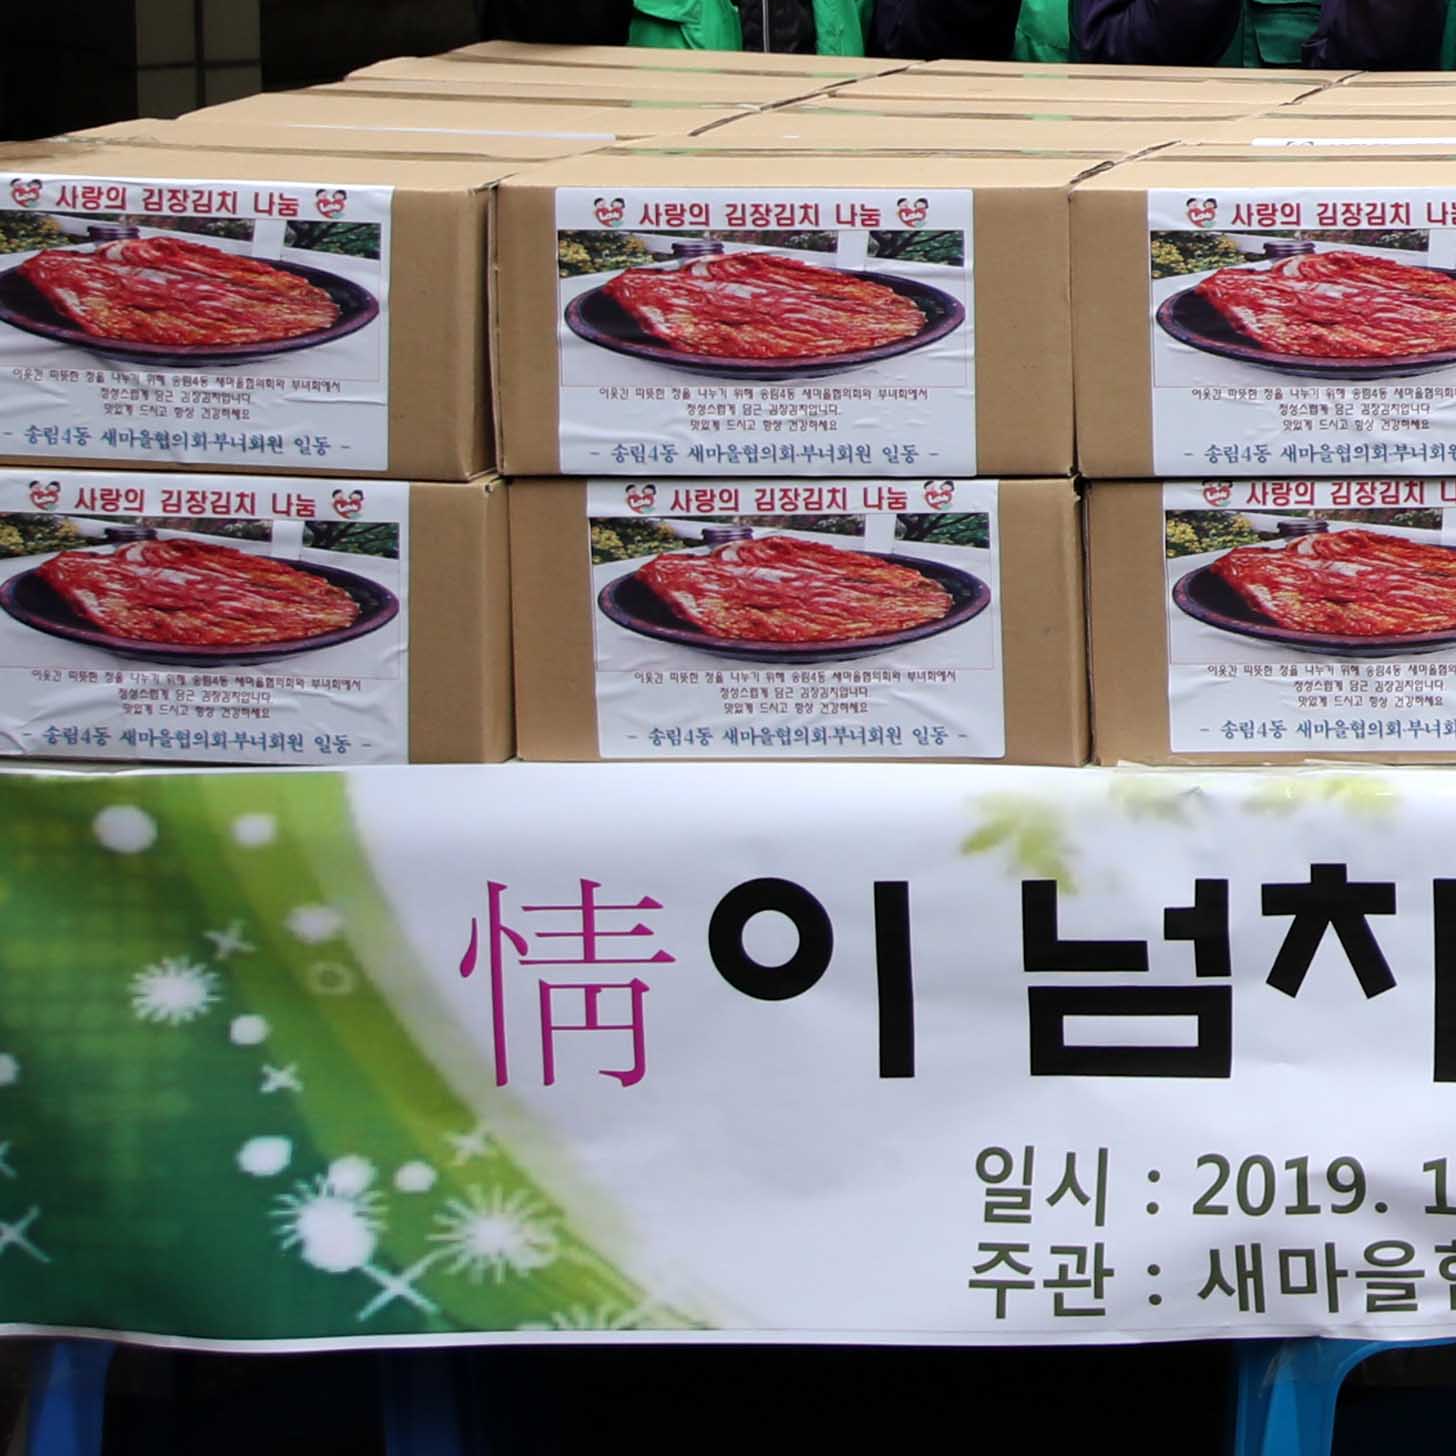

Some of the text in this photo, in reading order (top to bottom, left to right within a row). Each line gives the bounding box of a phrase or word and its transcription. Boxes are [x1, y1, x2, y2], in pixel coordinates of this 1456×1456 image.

[55, 185, 299, 217] 사랑의 김장김치 나눔
[640, 201, 881, 228] 사랑의 김장김치 나눔
[1232, 202, 1302, 229] 사랑의
[1316, 201, 1411, 227] 김장김치
[25, 424, 91, 447] 송림4동
[293, 435, 331, 457] 일동
[611, 443, 679, 464] 송림4동
[881, 444, 919, 465] 일동
[1204, 443, 1272, 465] 송림4동
[75, 486, 316, 518] 사랑의 김장김치 나눔
[671, 486, 907, 513] 사랑의 김장김치 나눔
[1246, 480, 1315, 507] 사랑의
[1329, 479, 1425, 506] 김장김치
[43, 725, 111, 747] 송림4동
[314, 734, 352, 755] 일동
[648, 726, 714, 747] 송림4동
[912, 725, 949, 746] 일동
[1220, 719, 1288, 740] 송림4동
[975, 1145, 1109, 1227] 일시
[1192, 1152, 1388, 1216] 2019.
[968, 1242, 1115, 1319] 주관
